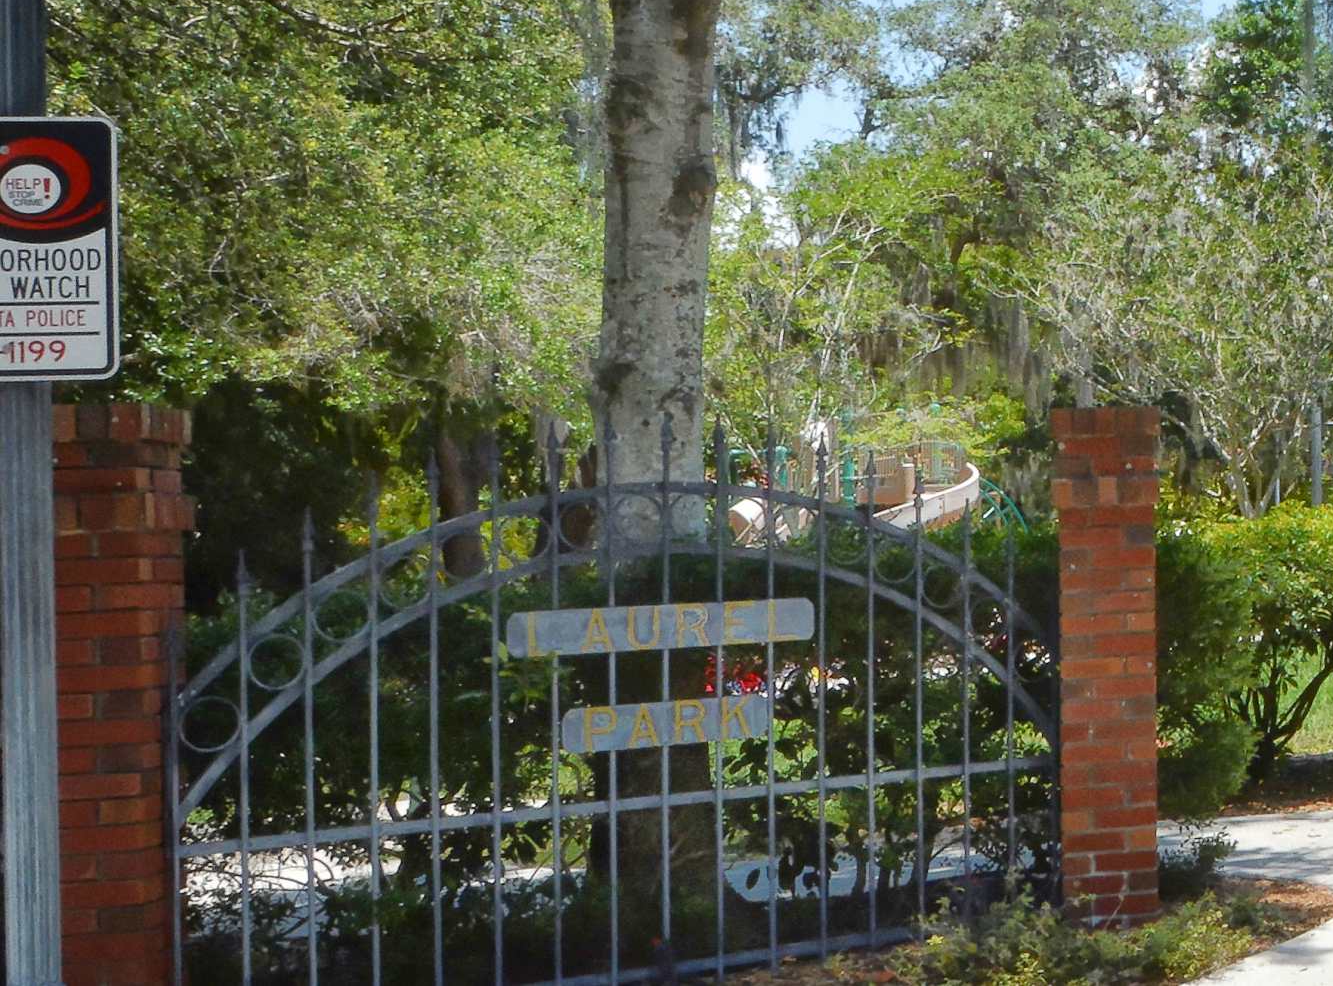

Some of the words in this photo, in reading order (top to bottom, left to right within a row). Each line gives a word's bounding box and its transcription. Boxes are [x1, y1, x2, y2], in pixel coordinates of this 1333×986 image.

[8, 190, 36, 199] STOP
[12, 198, 44, 207] CRIME
[10, 275, 91, 299] WATCH
[26, 309, 87, 327] POLICE
[526, 598, 801, 658] LAUREL
[582, 695, 752, 753] PARK
